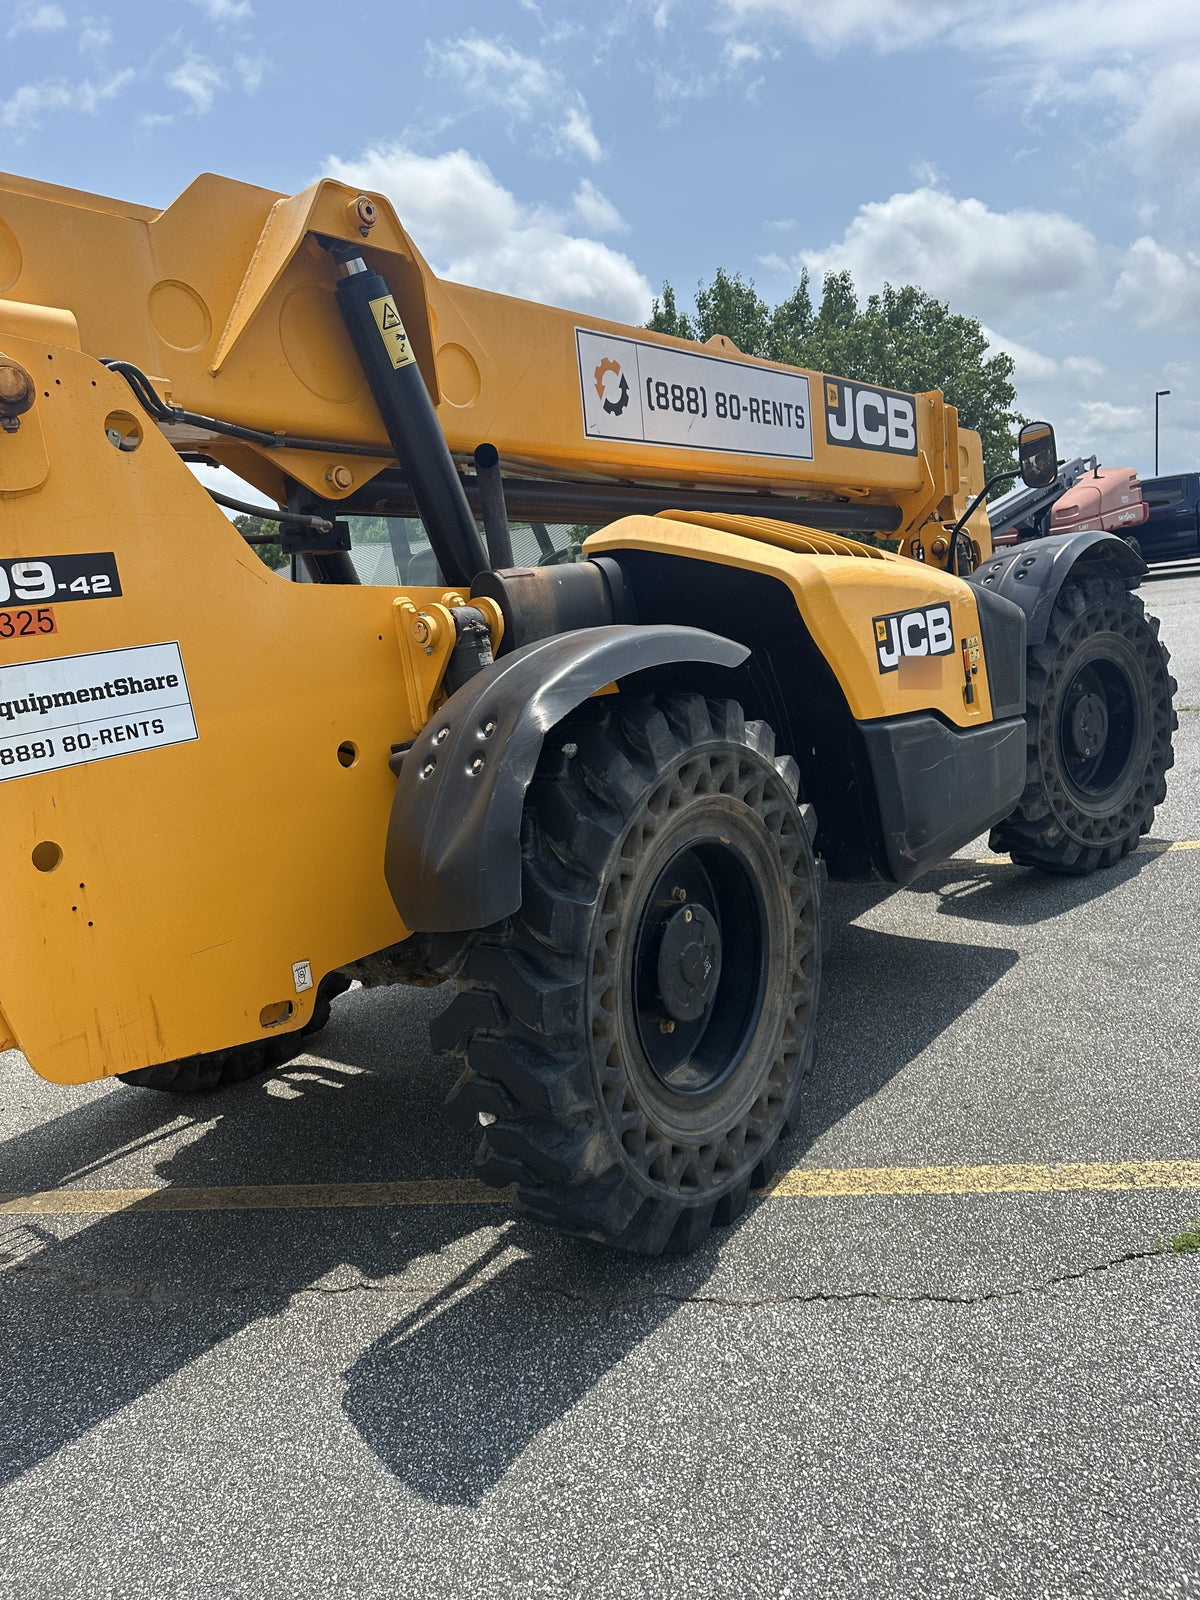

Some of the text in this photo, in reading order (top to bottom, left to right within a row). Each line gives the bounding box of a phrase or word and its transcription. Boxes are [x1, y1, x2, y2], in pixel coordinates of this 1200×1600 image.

[646, 377, 805, 430] (888) 80-RENTS
[828, 387, 916, 451] JCB
[0, 561, 112, 602] 9-42
[0, 608, 55, 637] 325
[879, 607, 953, 667] JCB
[62, 719, 165, 752] 80-RENTS
